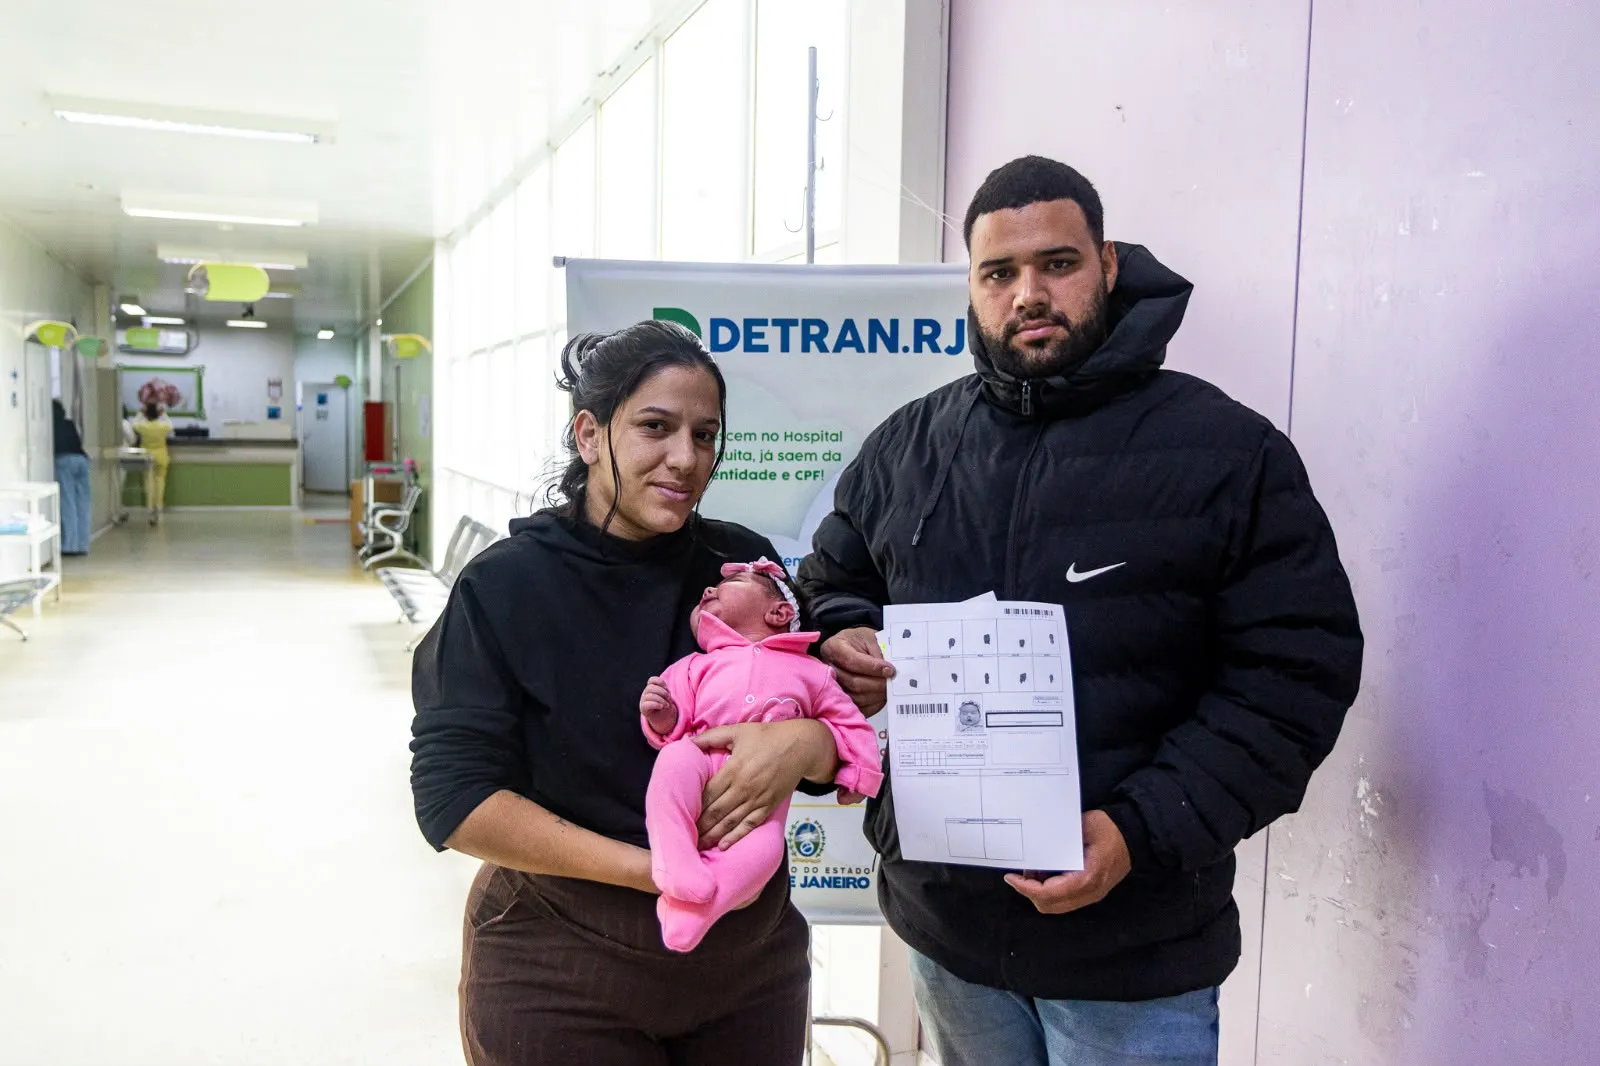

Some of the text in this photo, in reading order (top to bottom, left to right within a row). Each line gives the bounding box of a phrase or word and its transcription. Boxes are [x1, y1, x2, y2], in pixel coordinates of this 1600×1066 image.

[710, 317, 965, 356] DETRAN.RJ
[761, 432, 780, 442] no
[784, 431, 843, 444] Hospital
[720, 449, 842, 463] uita, já saem da
[712, 468, 825, 481] entidade e CPF!
[804, 866, 819, 874] DO
[825, 867, 871, 875] ESTADO
[800, 876, 870, 889] JANEIRO
